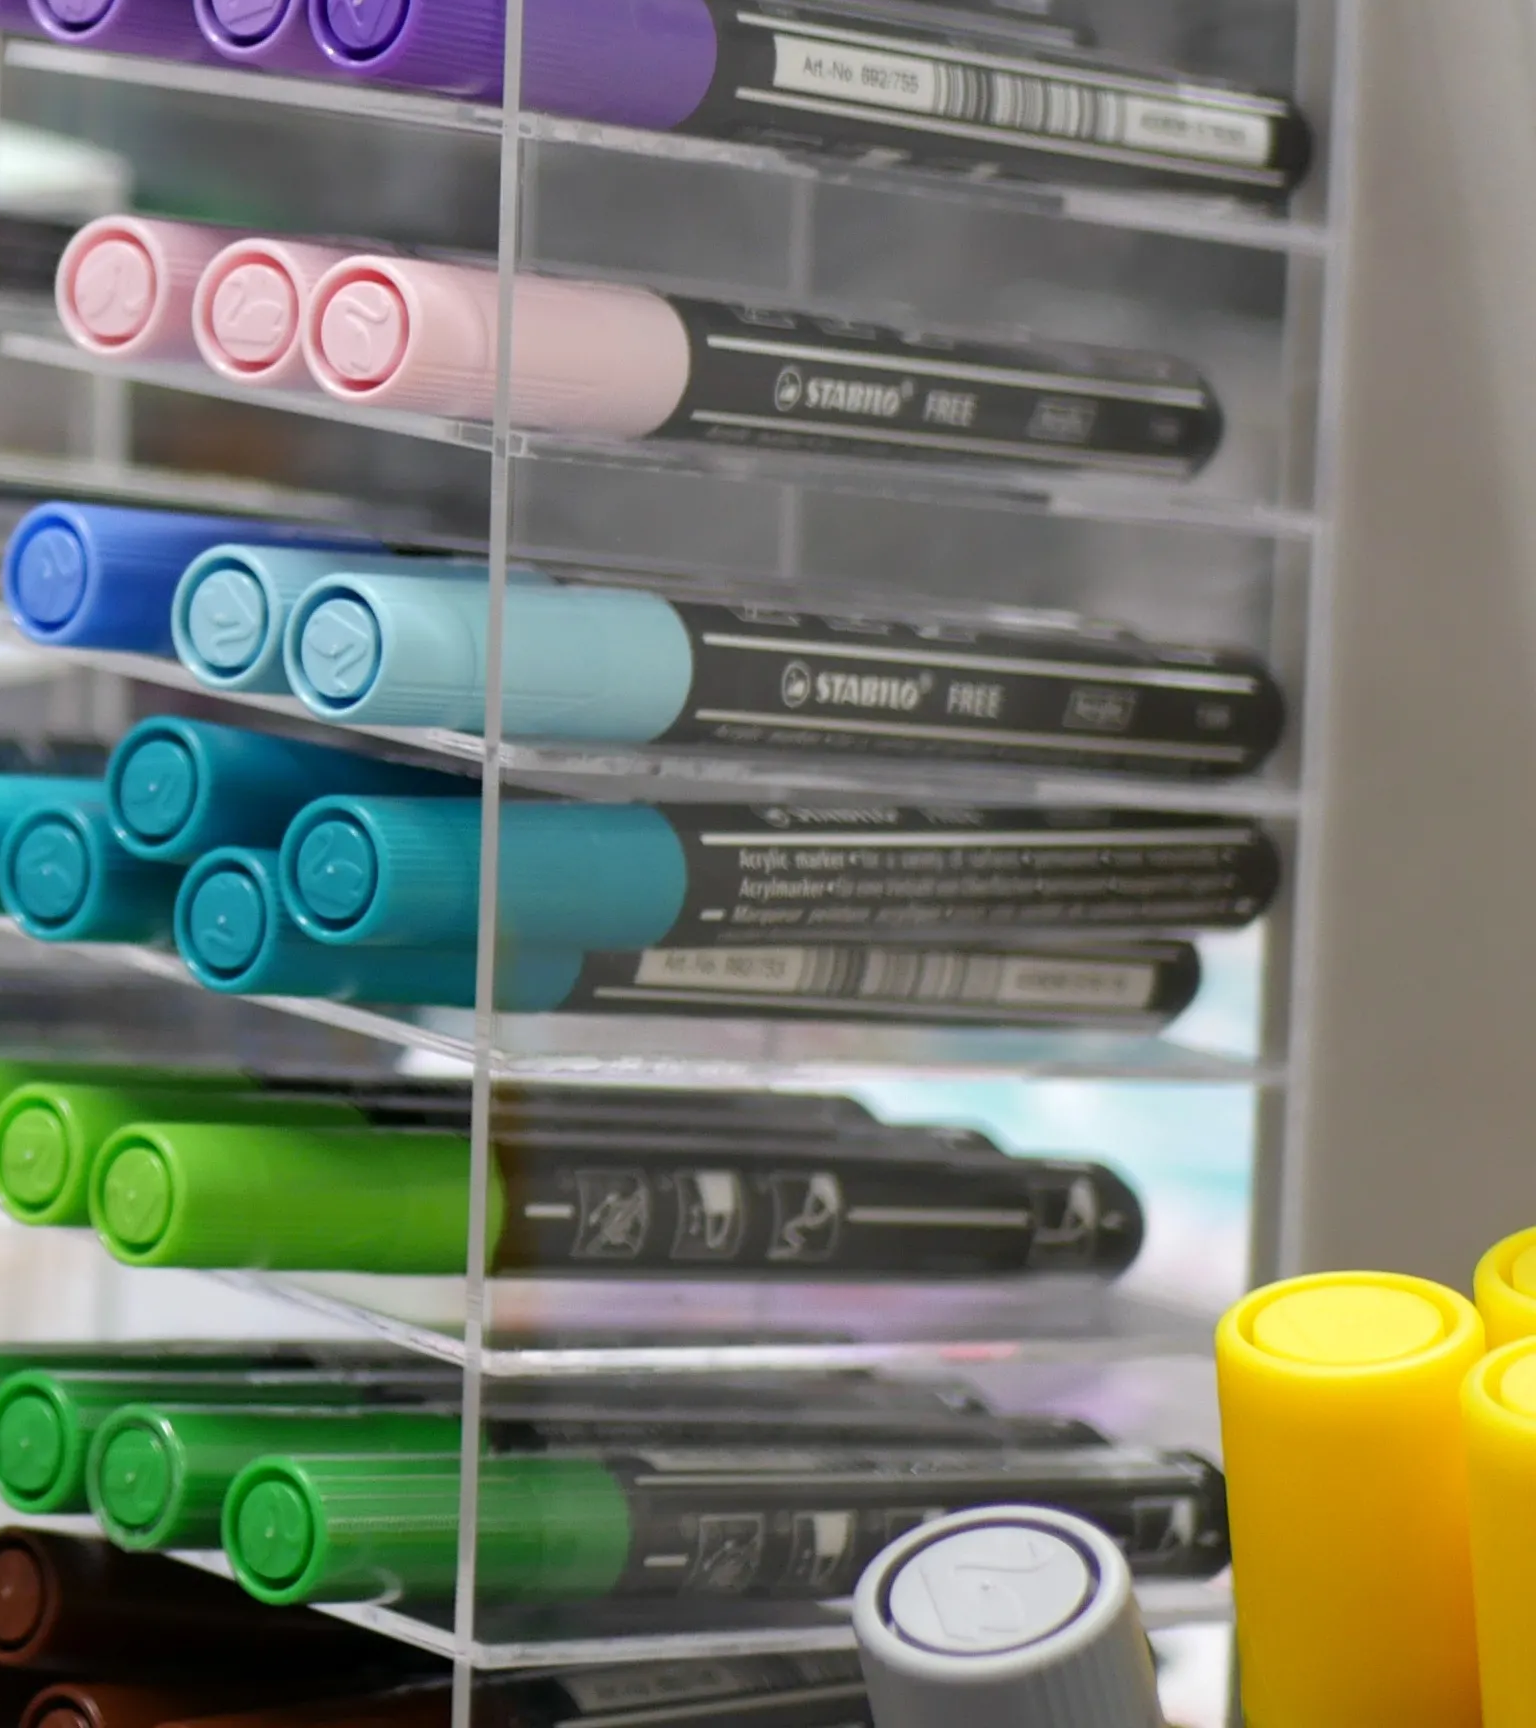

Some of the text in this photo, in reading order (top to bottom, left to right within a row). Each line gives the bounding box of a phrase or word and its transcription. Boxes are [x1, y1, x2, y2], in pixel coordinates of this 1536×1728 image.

[804, 376, 978, 428] STABILO FREE
[815, 670, 1005, 719] STABILO FREE
